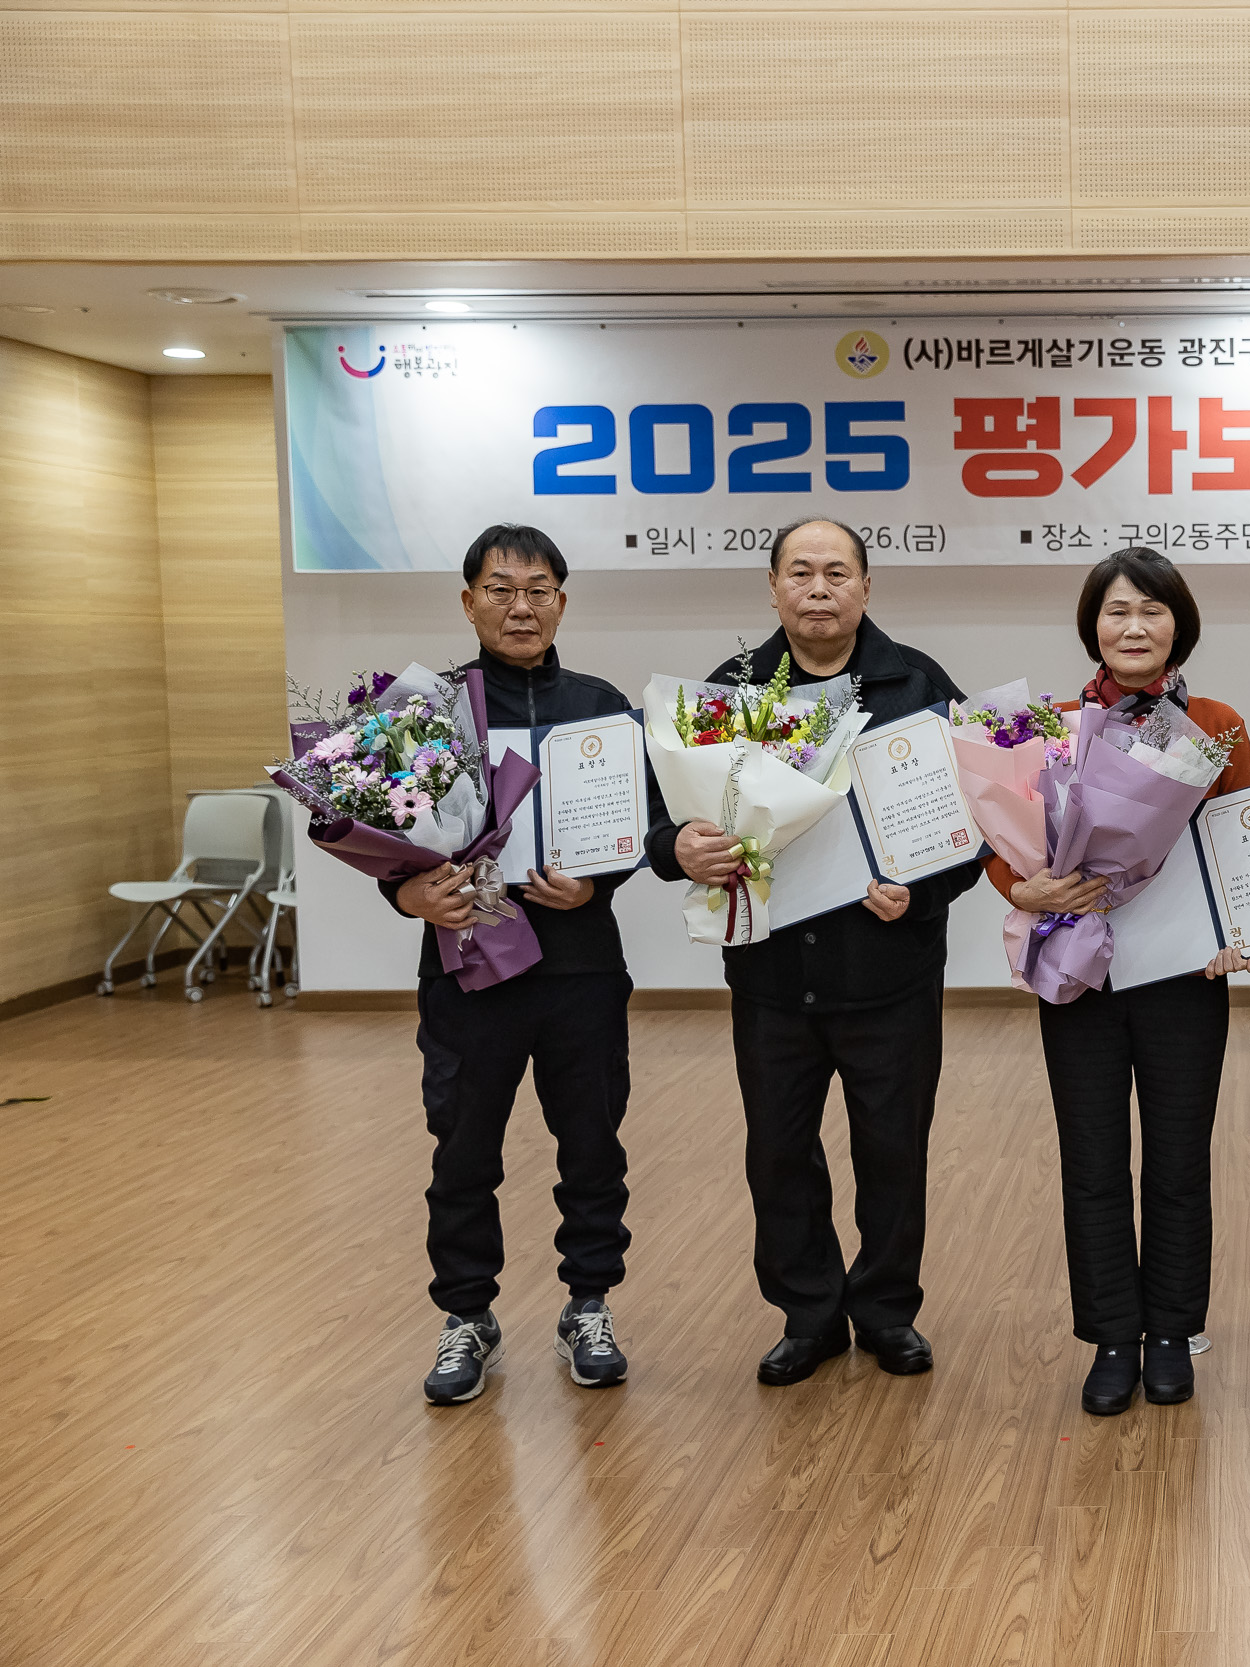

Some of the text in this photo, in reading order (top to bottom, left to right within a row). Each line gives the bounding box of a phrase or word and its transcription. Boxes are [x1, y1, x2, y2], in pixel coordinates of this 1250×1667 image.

[903, 337, 1166, 370] (사)바르게살기운동
[532, 400, 911, 496] 2025
[646, 527, 696, 555] 일시
[1042, 523, 1093, 551] 장소
